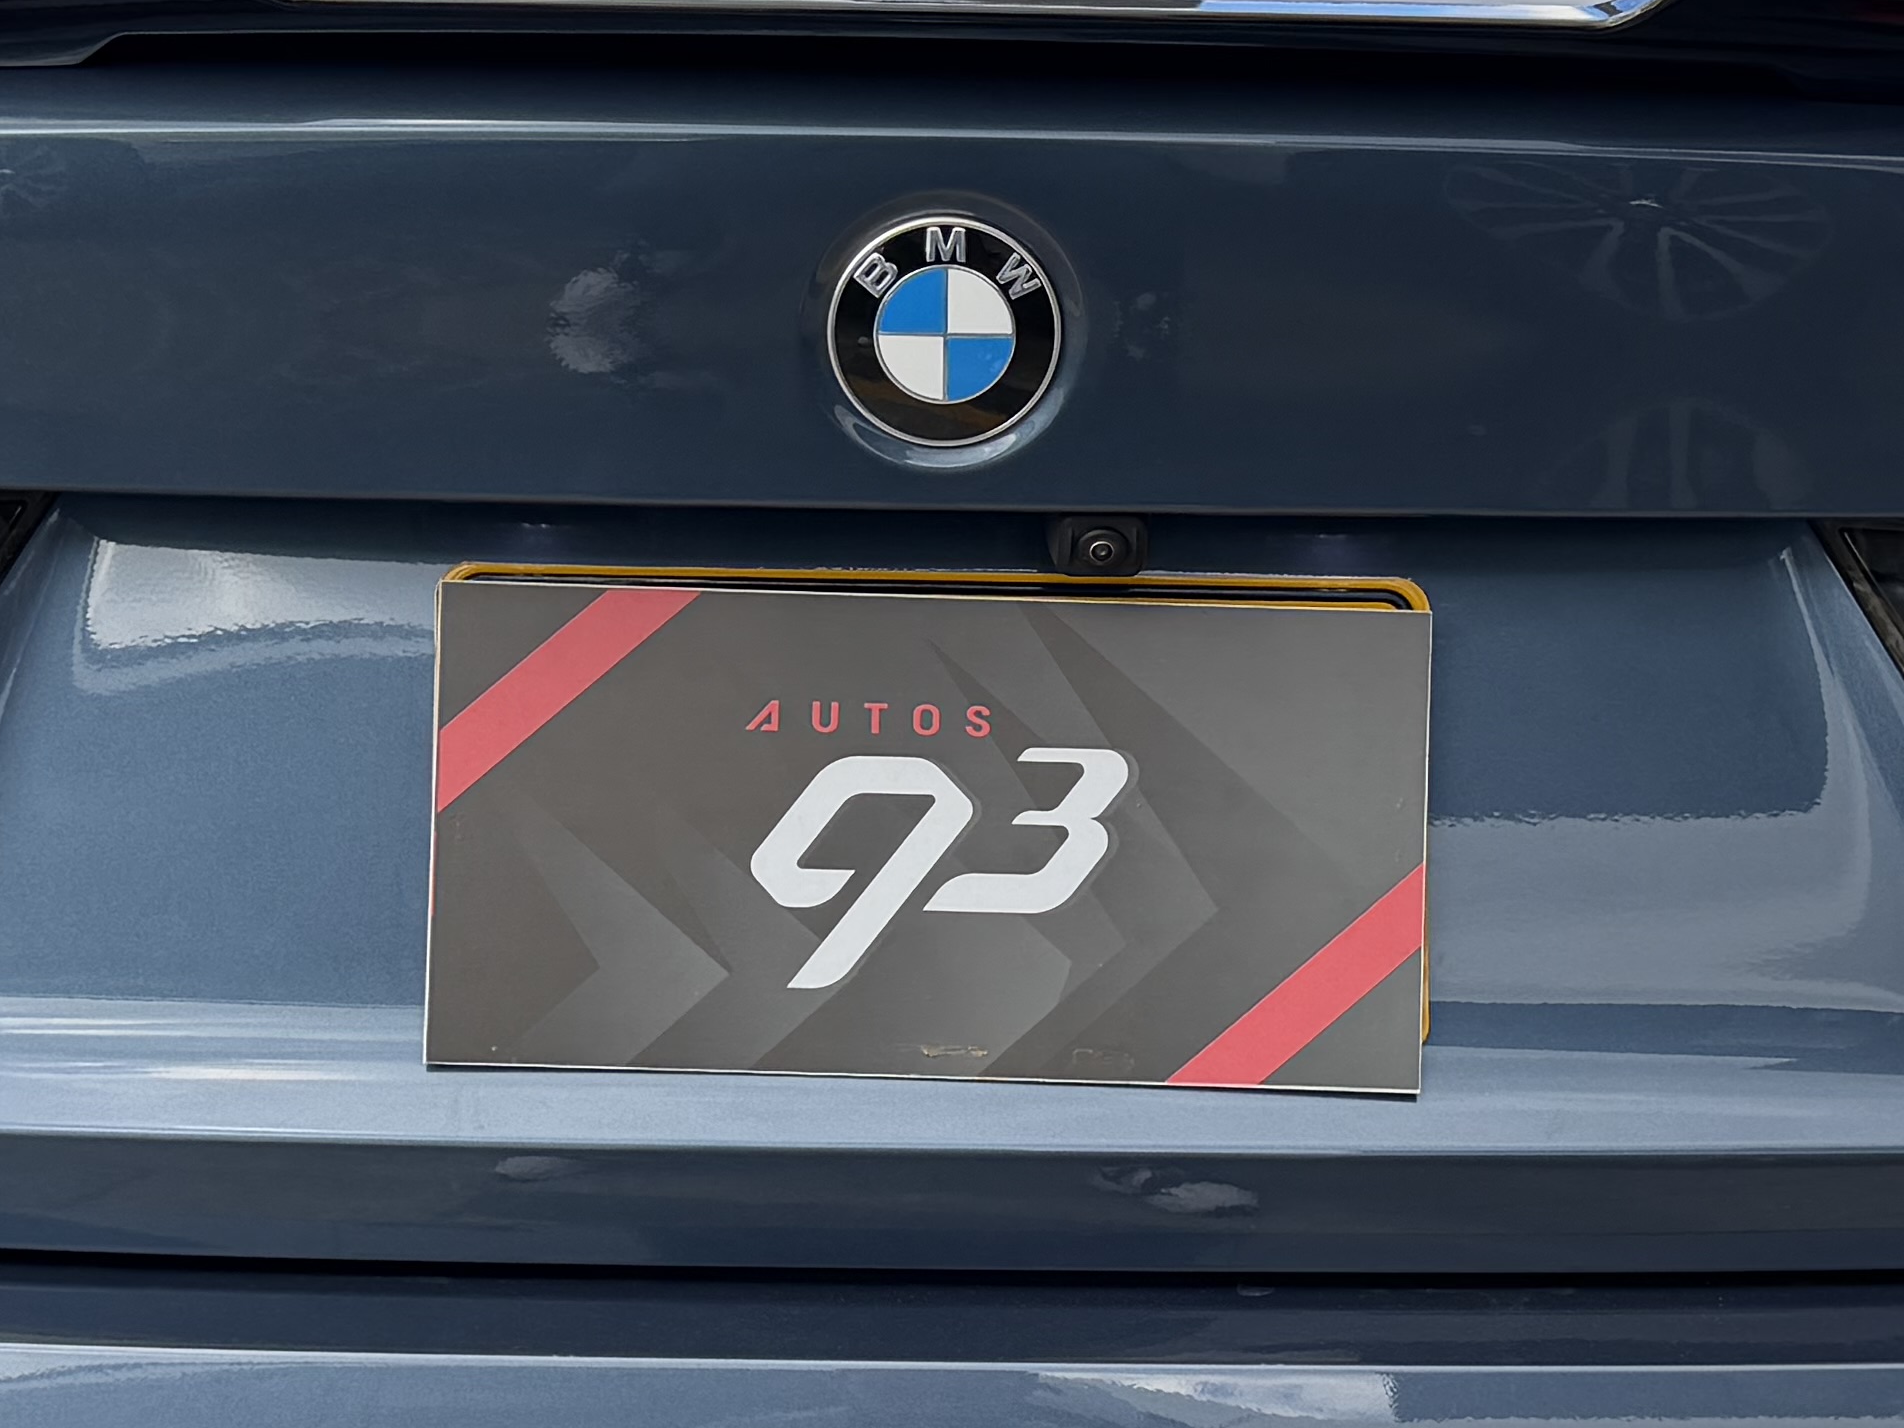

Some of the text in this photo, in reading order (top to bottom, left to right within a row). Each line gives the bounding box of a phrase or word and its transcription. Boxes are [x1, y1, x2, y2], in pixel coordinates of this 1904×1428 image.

[854, 226, 1041, 299] BMW
[745, 699, 991, 738] AUTOS
[750, 746, 1130, 989] 93
